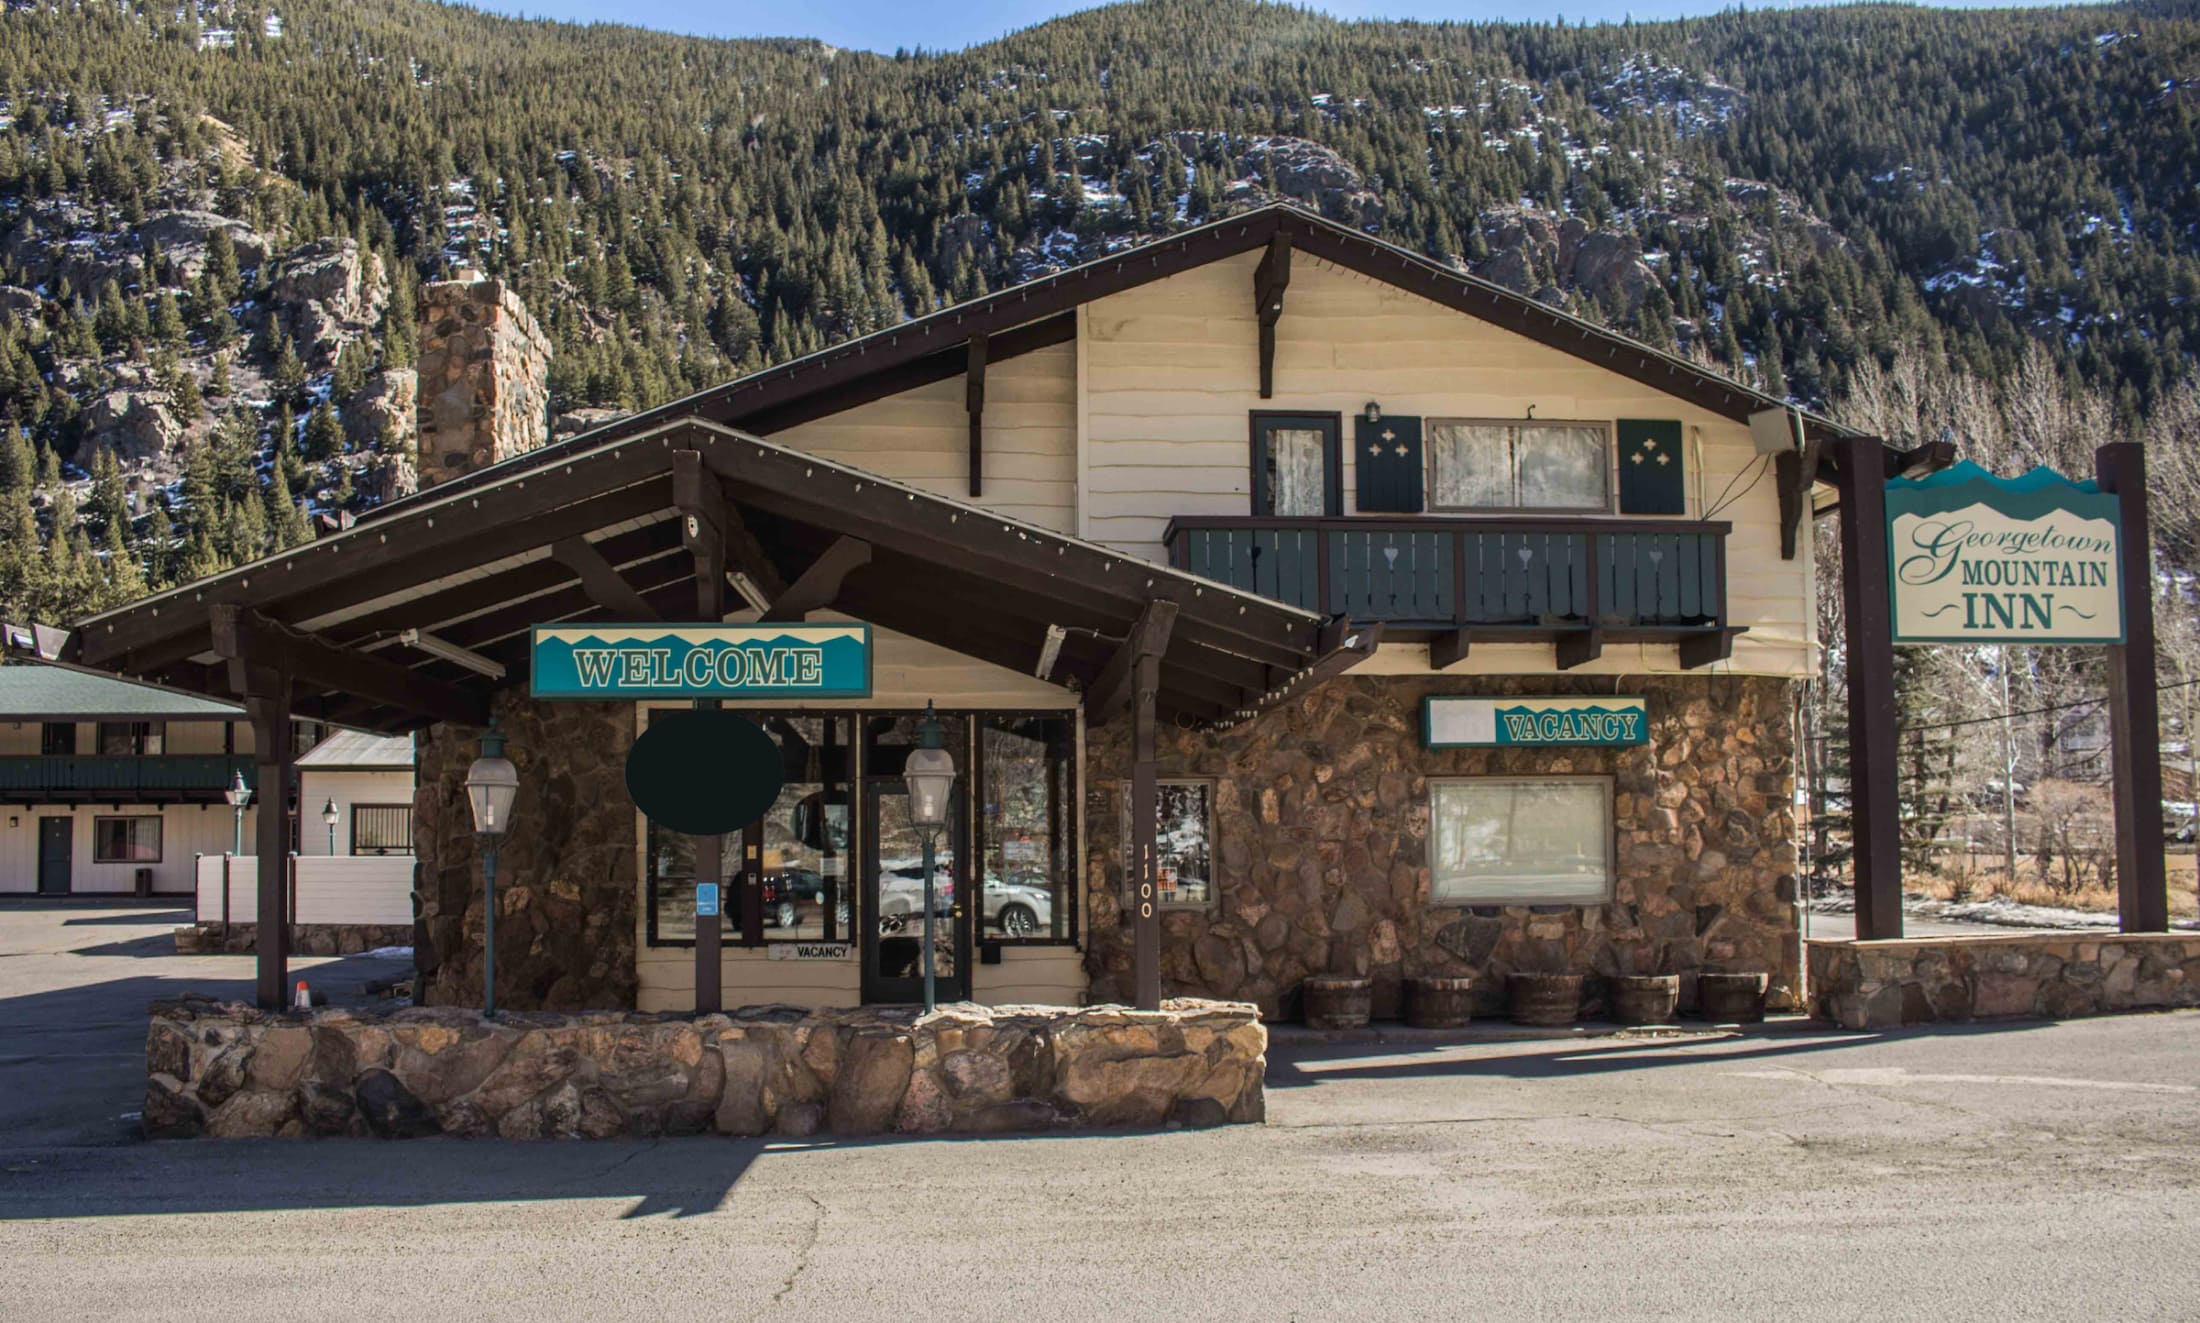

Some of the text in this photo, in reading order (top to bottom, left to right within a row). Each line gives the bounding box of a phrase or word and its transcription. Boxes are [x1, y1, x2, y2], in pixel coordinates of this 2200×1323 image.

[1899, 521, 2112, 586] Georgetown
[1961, 559, 2107, 587] MOUNTAIN
[1962, 592, 2054, 629] INN
[573, 648, 822, 687] WELCOME
[1504, 714, 1638, 741] VACANCY
[1141, 844, 1152, 918] 1100
[797, 946, 847, 958] VACANCY
